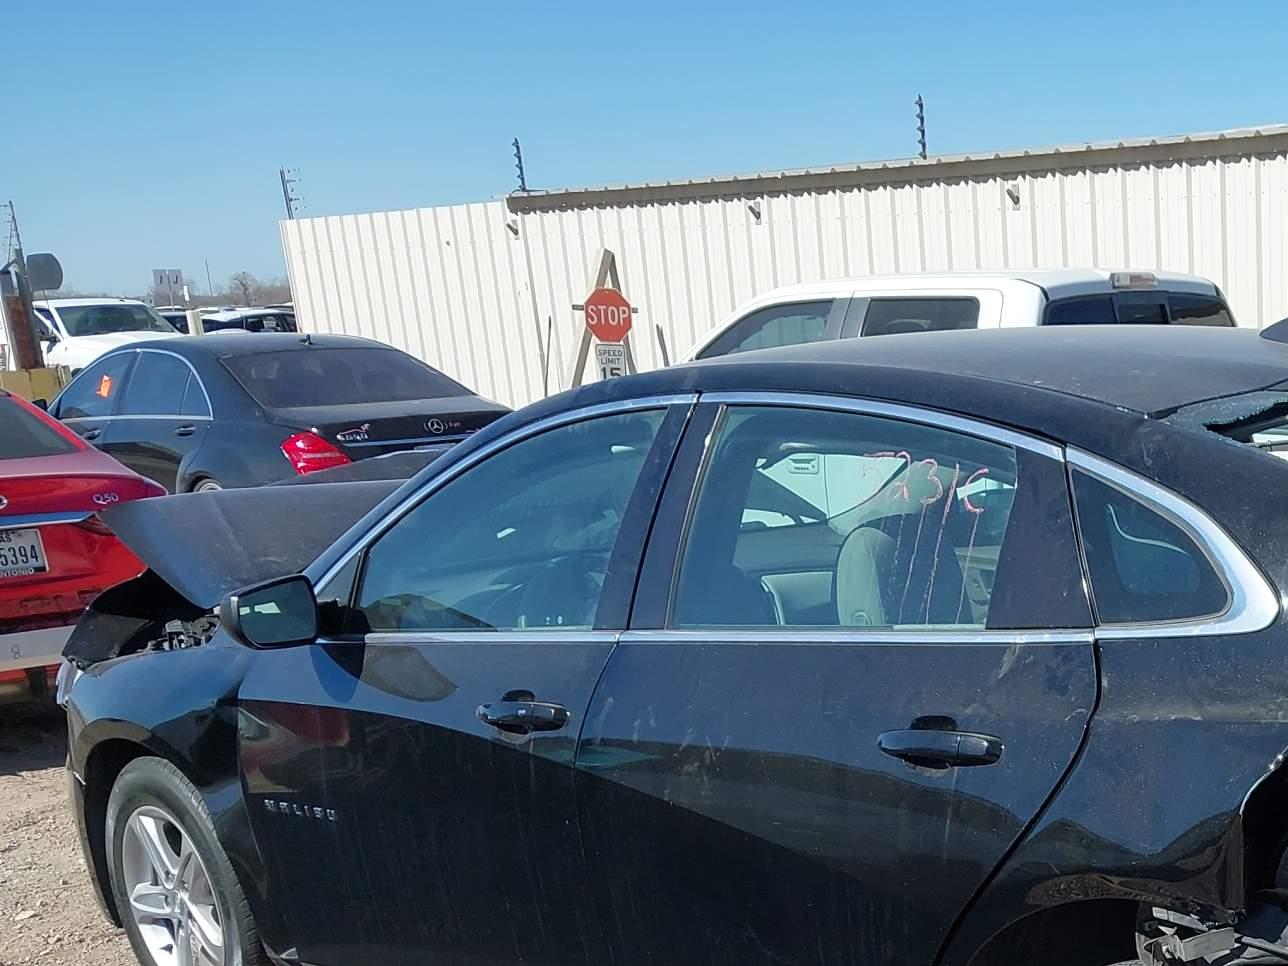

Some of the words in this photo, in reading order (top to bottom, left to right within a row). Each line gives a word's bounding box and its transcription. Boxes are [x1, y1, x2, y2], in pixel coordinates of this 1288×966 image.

[587, 306, 629, 326] STOP
[598, 349, 623, 357] SPEED
[600, 357, 621, 365] LIMIT
[92, 493, 118, 504] Q50
